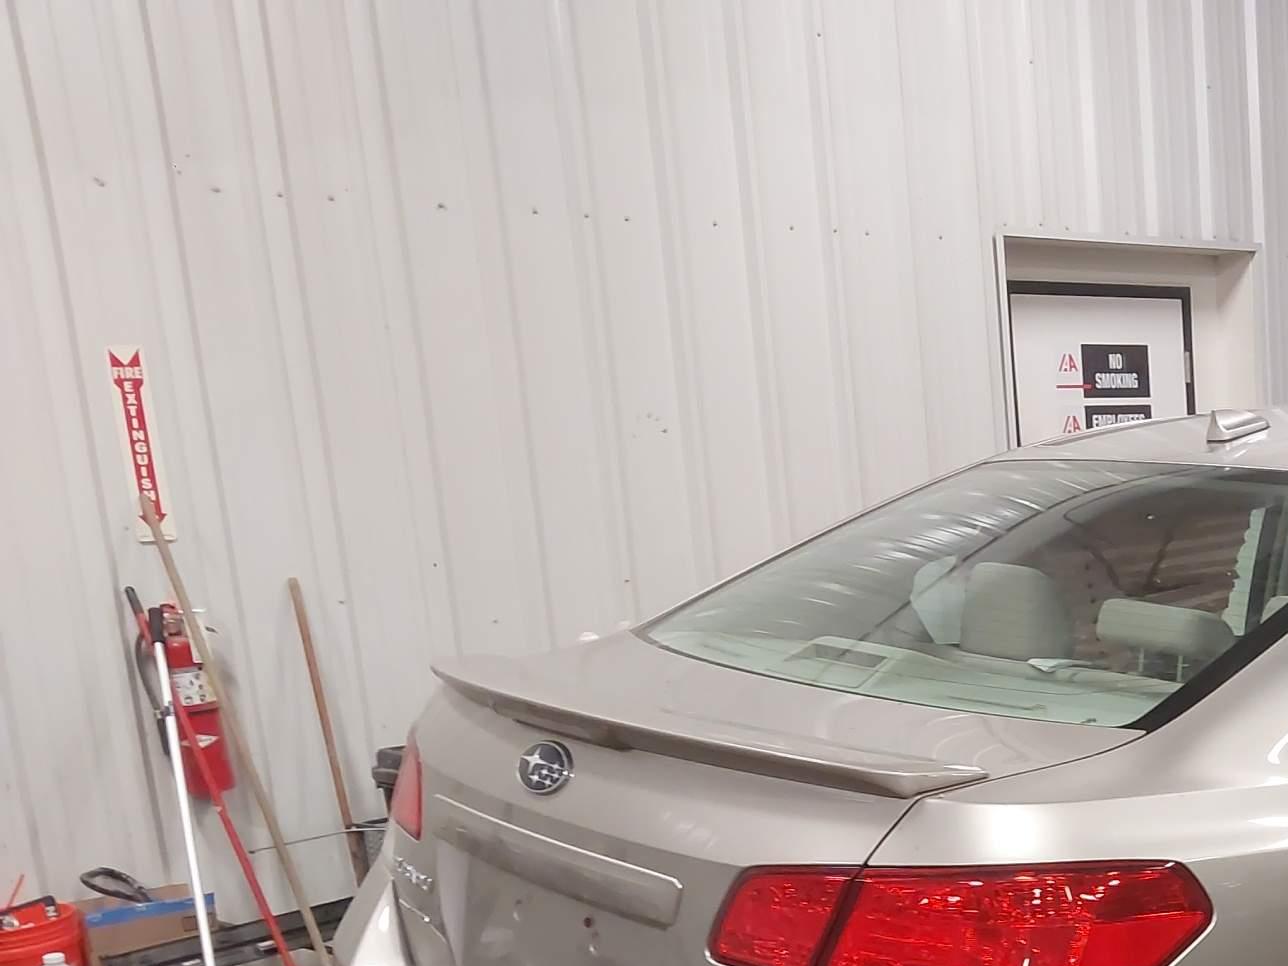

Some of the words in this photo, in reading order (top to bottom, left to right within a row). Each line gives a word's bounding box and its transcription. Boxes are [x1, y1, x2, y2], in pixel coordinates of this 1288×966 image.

[1108, 353, 1123, 369] NO
[112, 366, 143, 379] FIRE
[1095, 373, 1139, 389] SMOKING
[123, 381, 160, 519] EXTINGUISH
